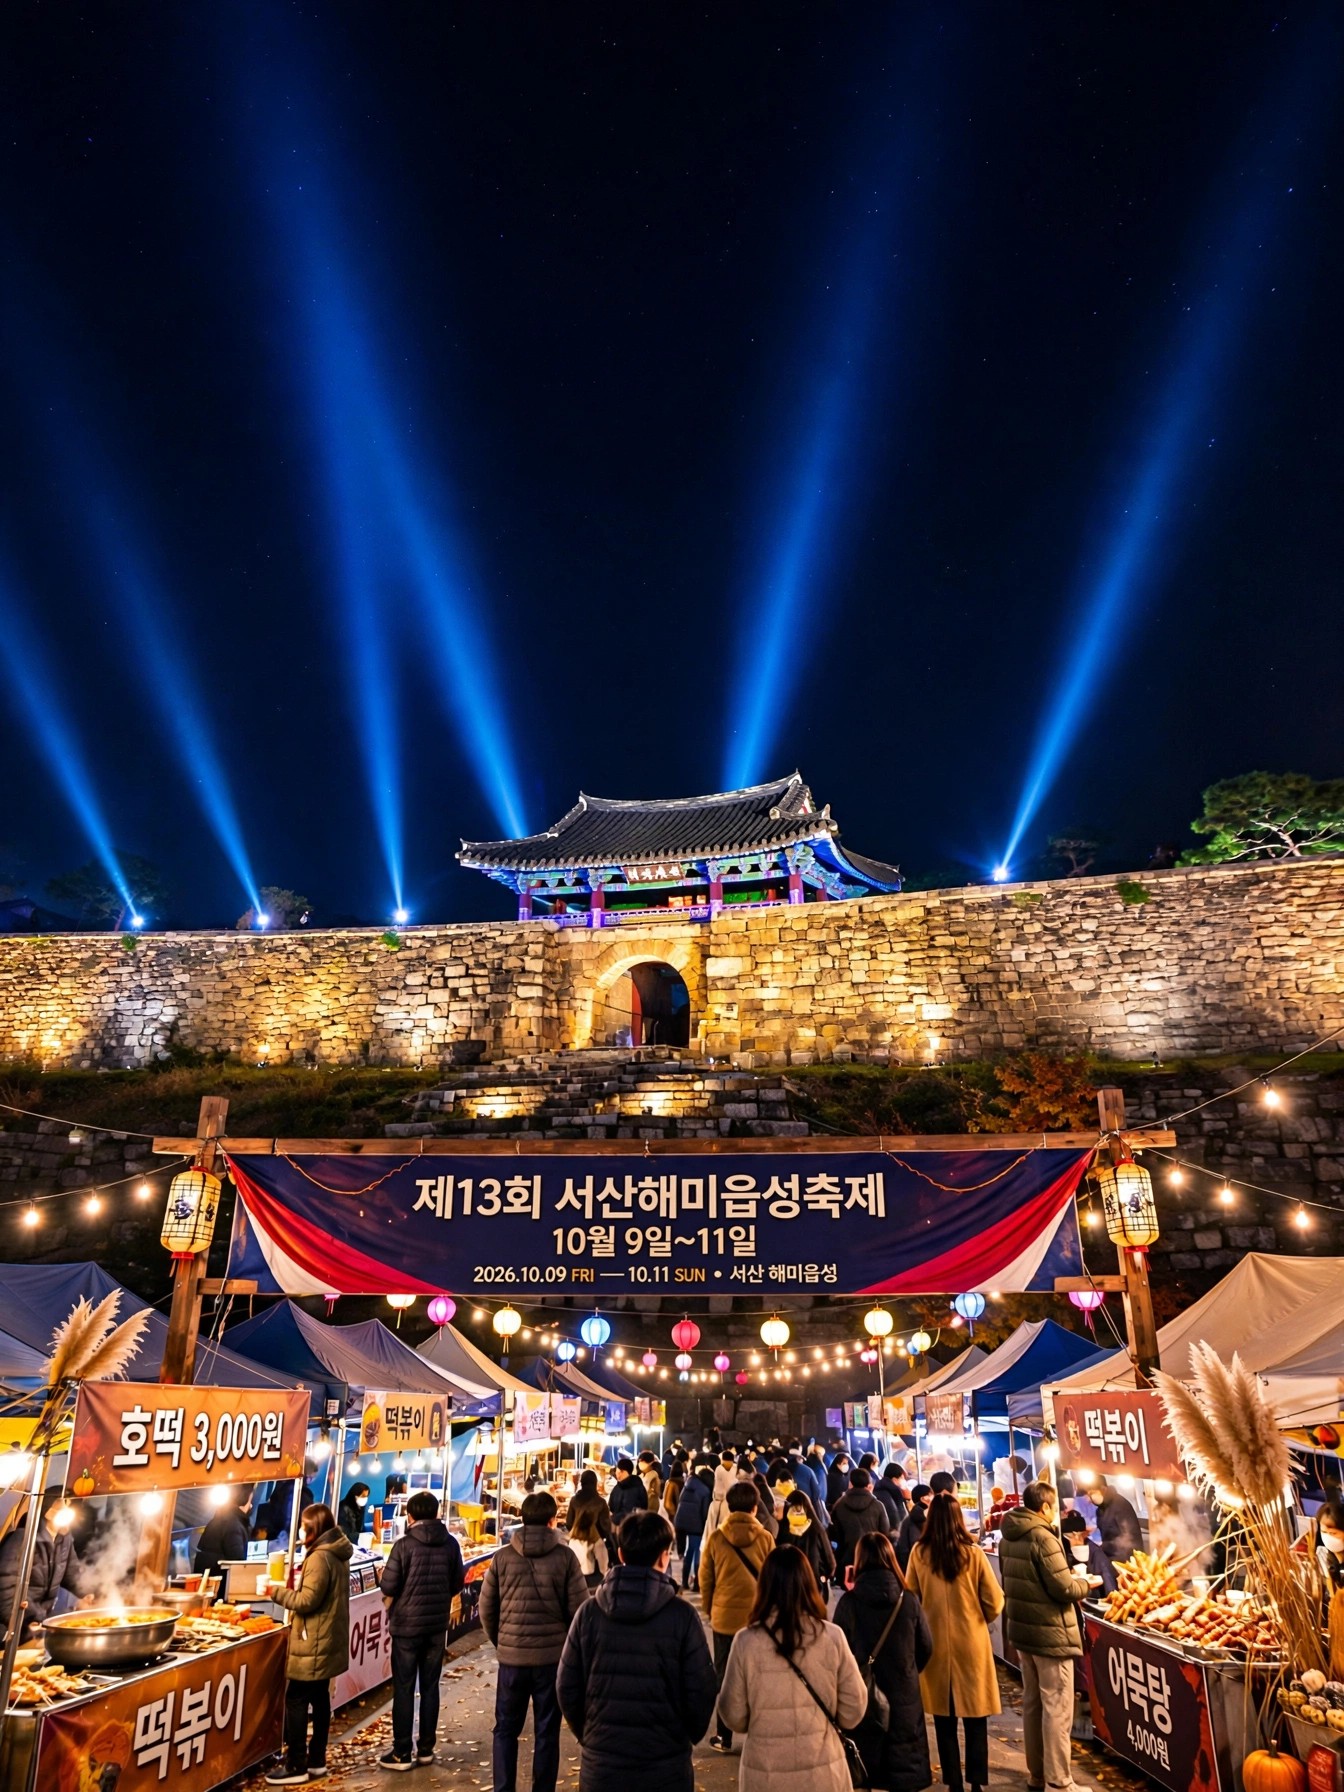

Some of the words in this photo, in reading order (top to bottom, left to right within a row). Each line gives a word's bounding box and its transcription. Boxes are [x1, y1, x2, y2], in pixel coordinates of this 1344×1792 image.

[411, 1174, 542, 1220] 제13회
[554, 1172, 886, 1220] 서산해미읍성축제
[552, 1225, 616, 1258] 10월
[624, 1224, 757, 1258] 9일~11일
[472, 1265, 567, 1283] 2026.10.09
[571, 1268, 595, 1283] FRI
[628, 1265, 669, 1283] 10.11
[674, 1267, 706, 1283] SUN
[729, 1263, 765, 1284] 서산
[768, 1263, 838, 1284] 해미읍성
[112, 1405, 185, 1468] 호떡
[190, 1411, 284, 1470] 3,000원
[385, 1405, 426, 1441] 떡볶이
[1083, 1408, 1150, 1465] 떡볶이
[1108, 1646, 1173, 1735] 어묵탕
[133, 1663, 247, 1780] 떡볶이
[1126, 1719, 1171, 1772] 4,000원
